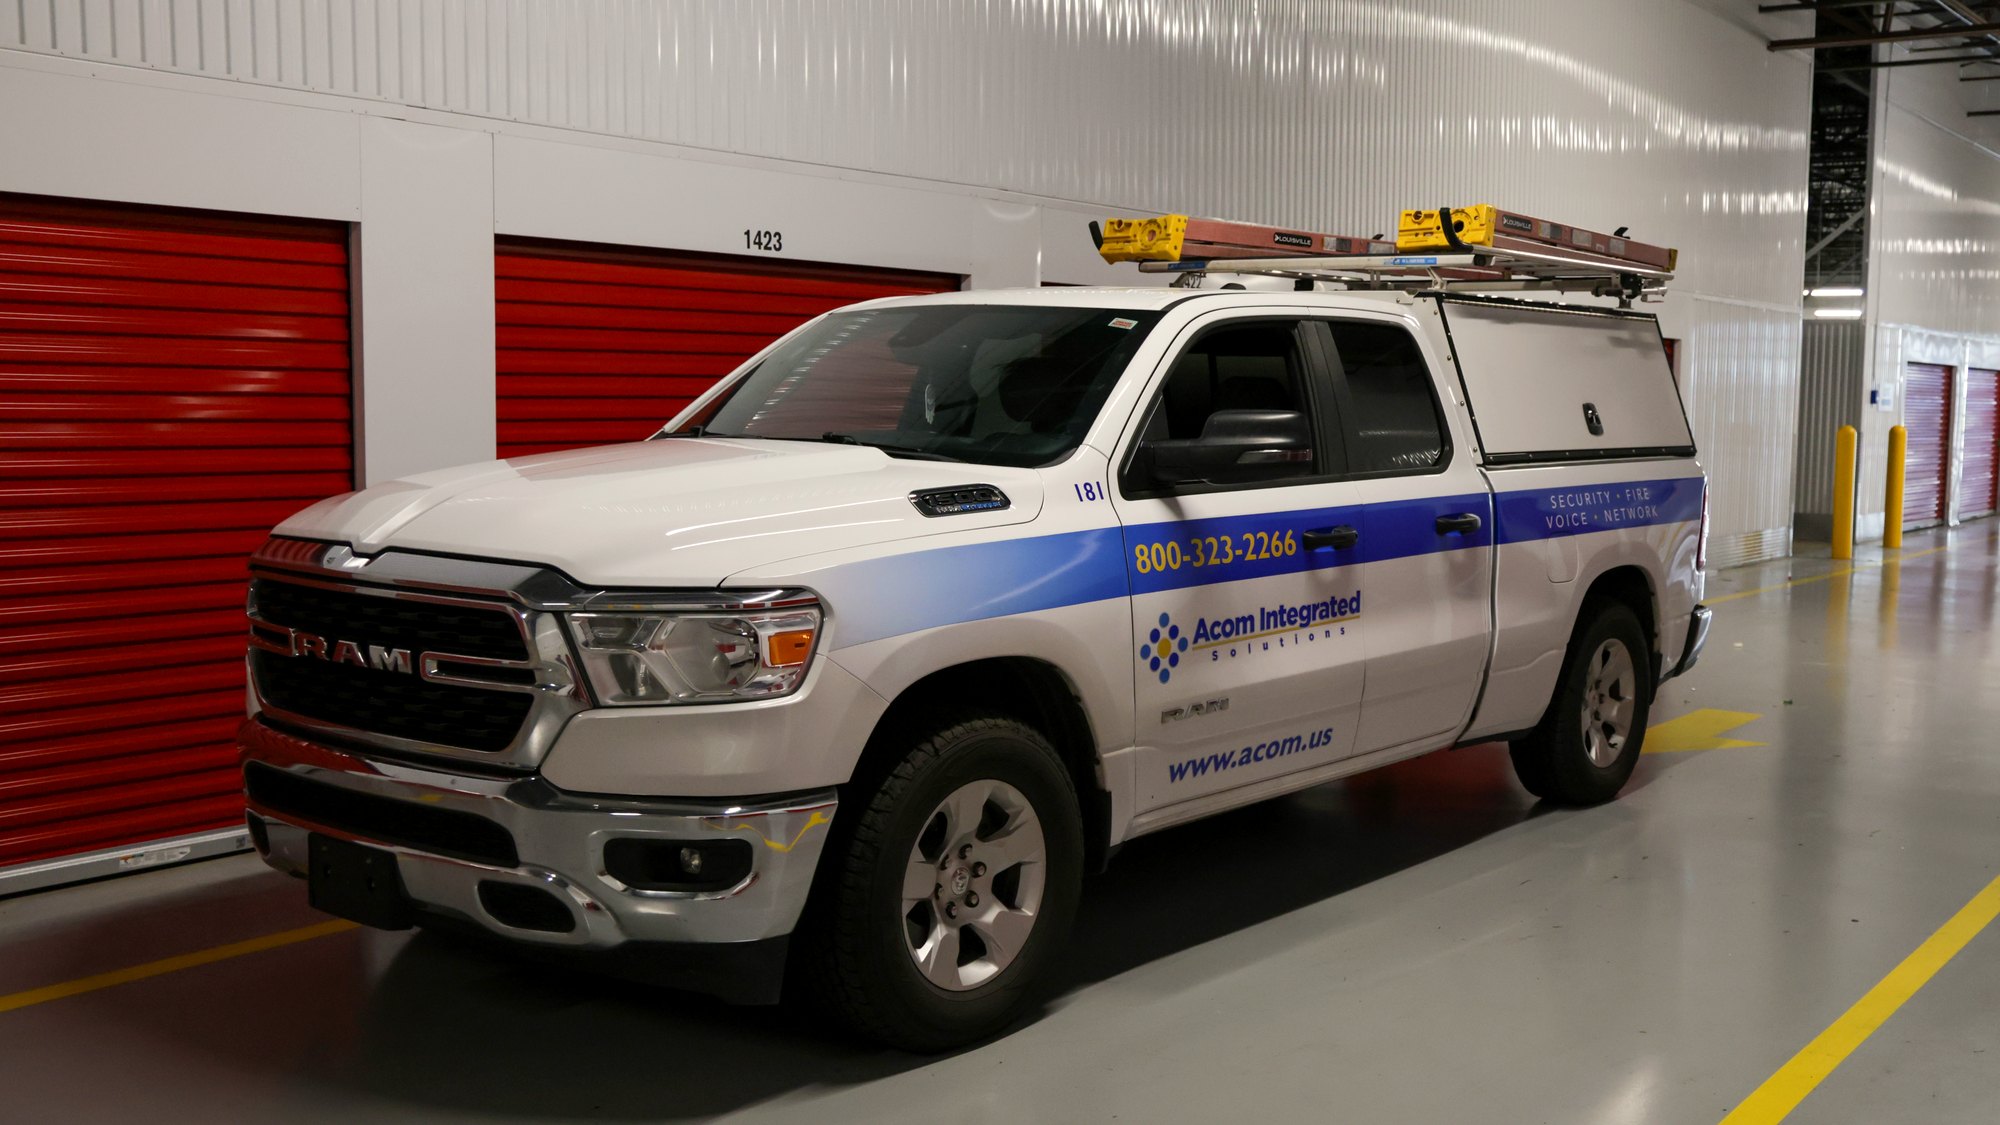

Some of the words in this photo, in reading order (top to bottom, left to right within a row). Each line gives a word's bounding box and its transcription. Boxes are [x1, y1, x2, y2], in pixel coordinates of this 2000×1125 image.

[744, 229, 782, 251] 1423
[1278, 235, 1312, 246] LOUISVILLE
[1074, 481, 1104, 502] 181
[1550, 491, 1610, 509] SECURITY
[1625, 487, 1650, 501] FIRE
[1546, 512, 1588, 528] VOICE
[1604, 505, 1658, 522] NETWORK
[1135, 529, 1297, 574] 800-323-2266
[1193, 614, 1255, 645] Acom
[1260, 591, 1361, 632] Integrated
[290, 628, 412, 674] RAM
[1212, 627, 1345, 661] Solutions
[1161, 698, 1229, 724] RAM
[1169, 728, 1333, 784] www.acom.us
